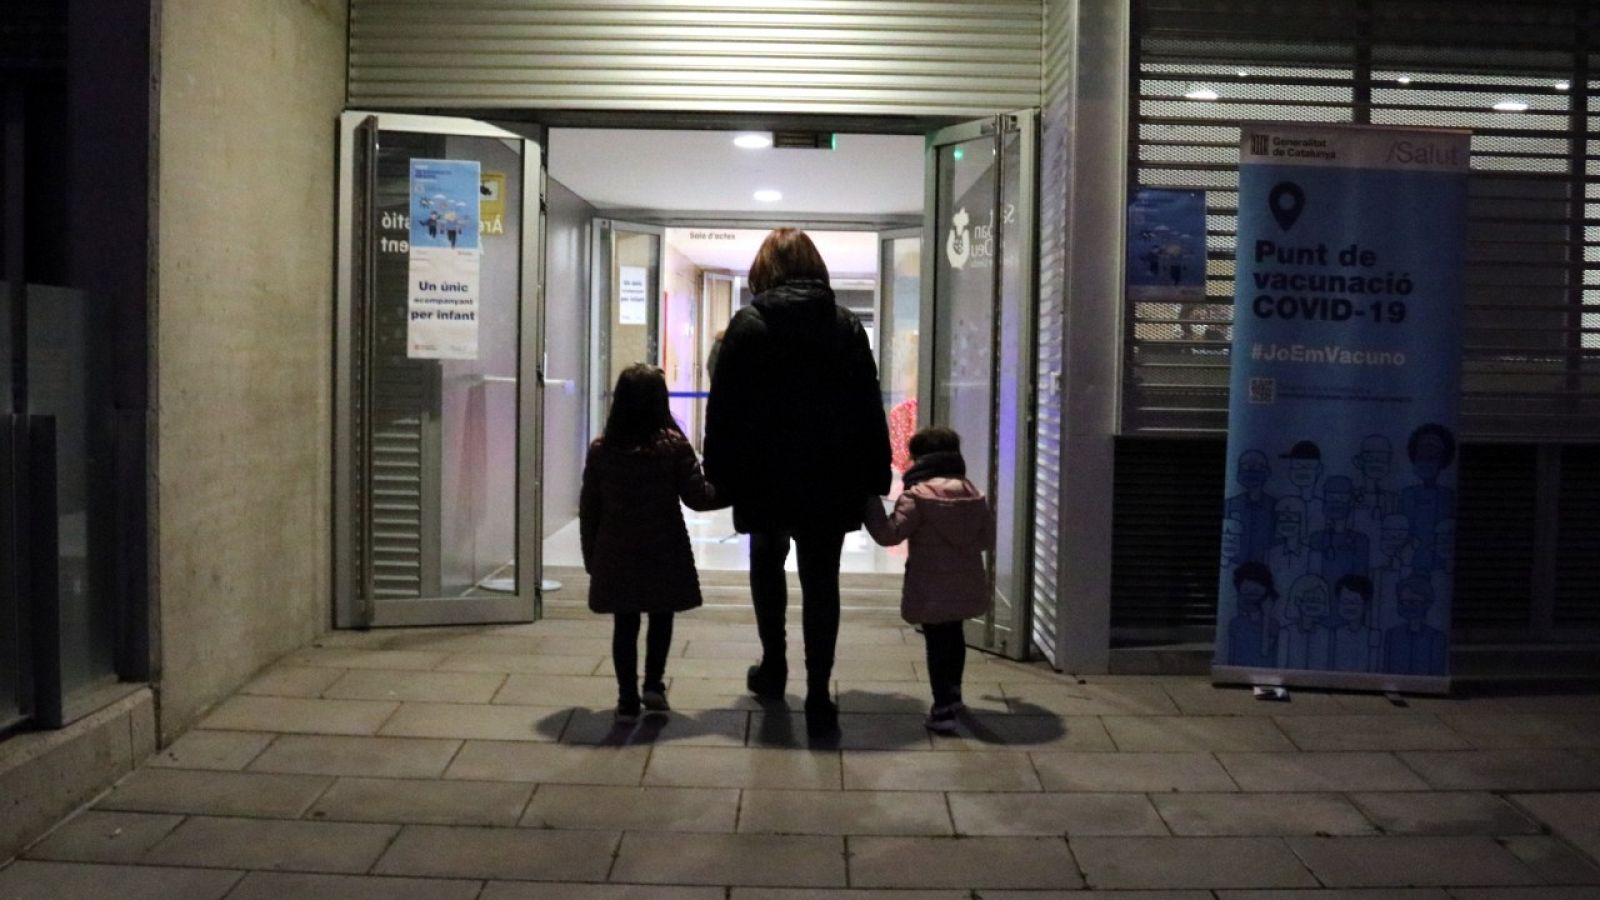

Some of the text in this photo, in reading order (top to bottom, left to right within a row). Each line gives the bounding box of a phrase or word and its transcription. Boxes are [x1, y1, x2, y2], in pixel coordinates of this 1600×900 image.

[1272, 136, 1327, 148] Generalitat
[1272, 147, 1336, 160] de Catalunya
[1255, 240, 1376, 268] Punt de
[419, 280, 468, 292] Un únic
[1253, 269, 1414, 296] vacunació
[413, 297, 474, 306] acompanyant
[410, 310, 475, 320] per infant
[1253, 296, 1406, 324] COVID-19
[1251, 343, 1406, 366] #JoEmVacuno
